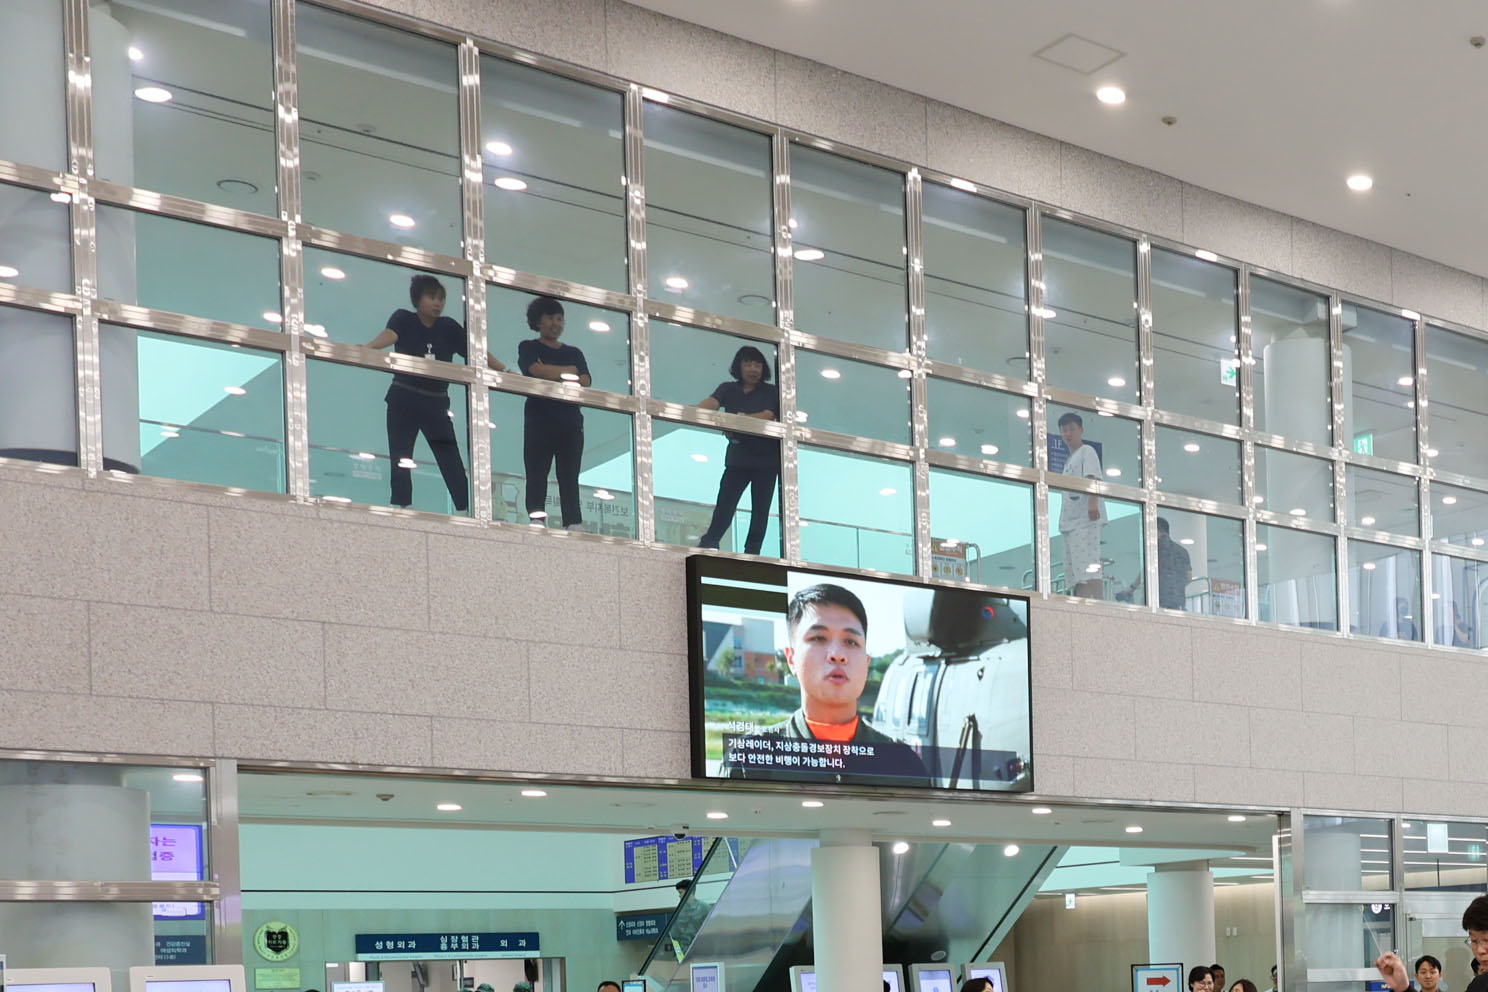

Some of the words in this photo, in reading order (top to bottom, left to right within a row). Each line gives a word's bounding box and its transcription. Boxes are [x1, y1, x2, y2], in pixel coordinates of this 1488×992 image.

[728, 738, 774, 752] 기상레이더,
[775, 740, 841, 755] 지상충돌경보장치
[843, 745, 875, 756] 장착으로
[728, 753, 746, 763] 보다
[748, 753, 773, 765] 안전한
[775, 755, 801, 767] 비행이
[802, 756, 846, 769] 가능합니다.
[375, 940, 417, 950] 성형외과
[440, 942, 480, 950] 흉부외과
[440, 935, 480, 943] 심장혈관
